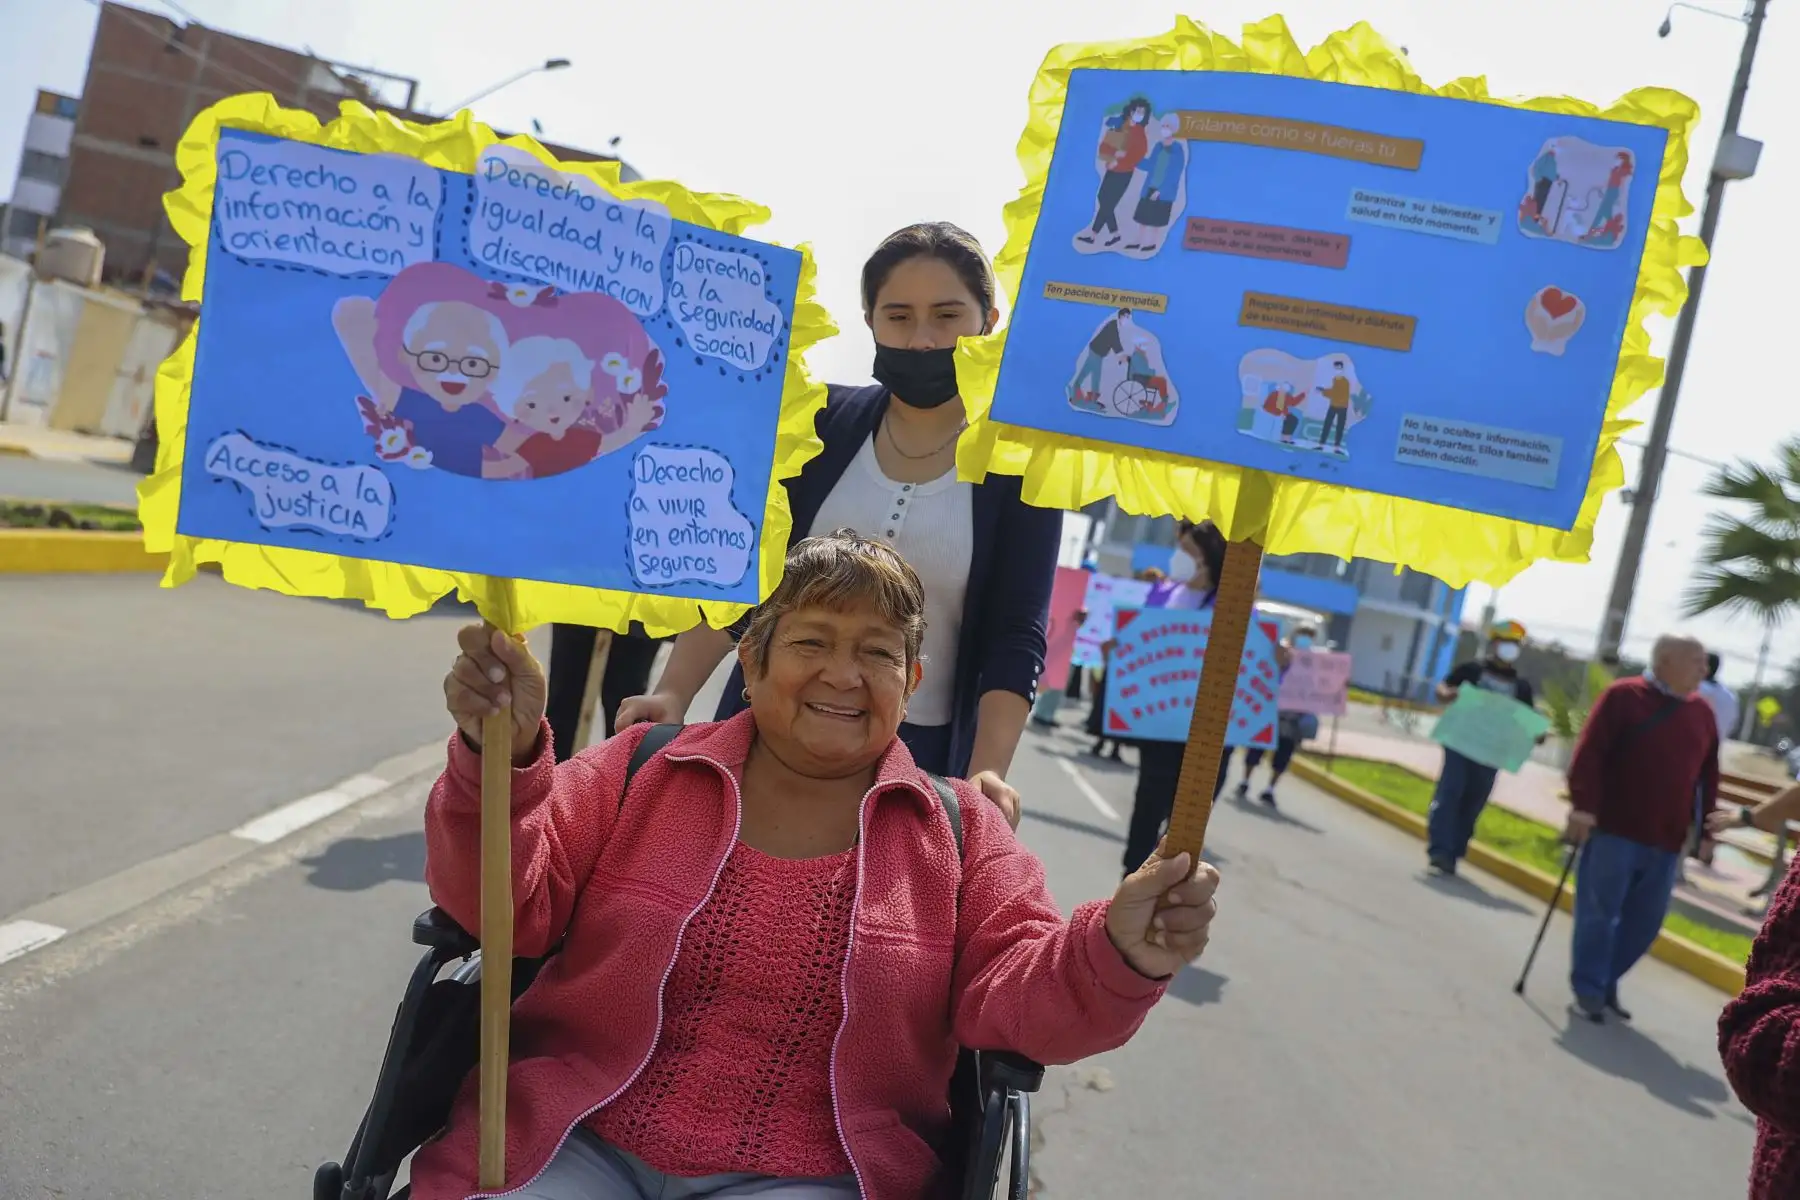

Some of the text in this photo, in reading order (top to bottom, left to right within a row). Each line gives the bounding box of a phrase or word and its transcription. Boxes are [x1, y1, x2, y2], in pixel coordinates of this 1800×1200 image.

[1250, 123, 1300, 141] como
[1304, 129, 1317, 143] si
[1320, 131, 1374, 155] fueras
[220, 150, 433, 211] Derecho a la
[484, 157, 656, 244] Derecho a la
[1351, 205, 1380, 219] salud
[1382, 212, 1396, 221] en
[1399, 213, 1424, 226] todo
[1412, 202, 1425, 212] su
[1431, 205, 1483, 222] bienestar
[1488, 215, 1496, 225] y
[224, 191, 423, 247] información y
[481, 197, 602, 255] igualdad
[230, 226, 404, 267] orientacion
[676, 246, 762, 286] Derecho
[671, 278, 722, 303] a la
[1047, 283, 1062, 293] Ten
[1064, 286, 1110, 301] paciencia
[1111, 294, 1117, 304] y
[694, 333, 755, 364] social
[1404, 418, 1419, 430] No
[1423, 421, 1438, 433] les
[1443, 426, 1482, 440] ocultes
[1398, 446, 1438, 460] pueden
[1401, 432, 1414, 442] no
[1416, 434, 1431, 444] les
[1478, 445, 1504, 458] Ellos
[209, 444, 383, 506] Acceso a la
[637, 454, 724, 485] Derecho
[632, 497, 649, 513] a
[633, 518, 746, 550] en entornos
